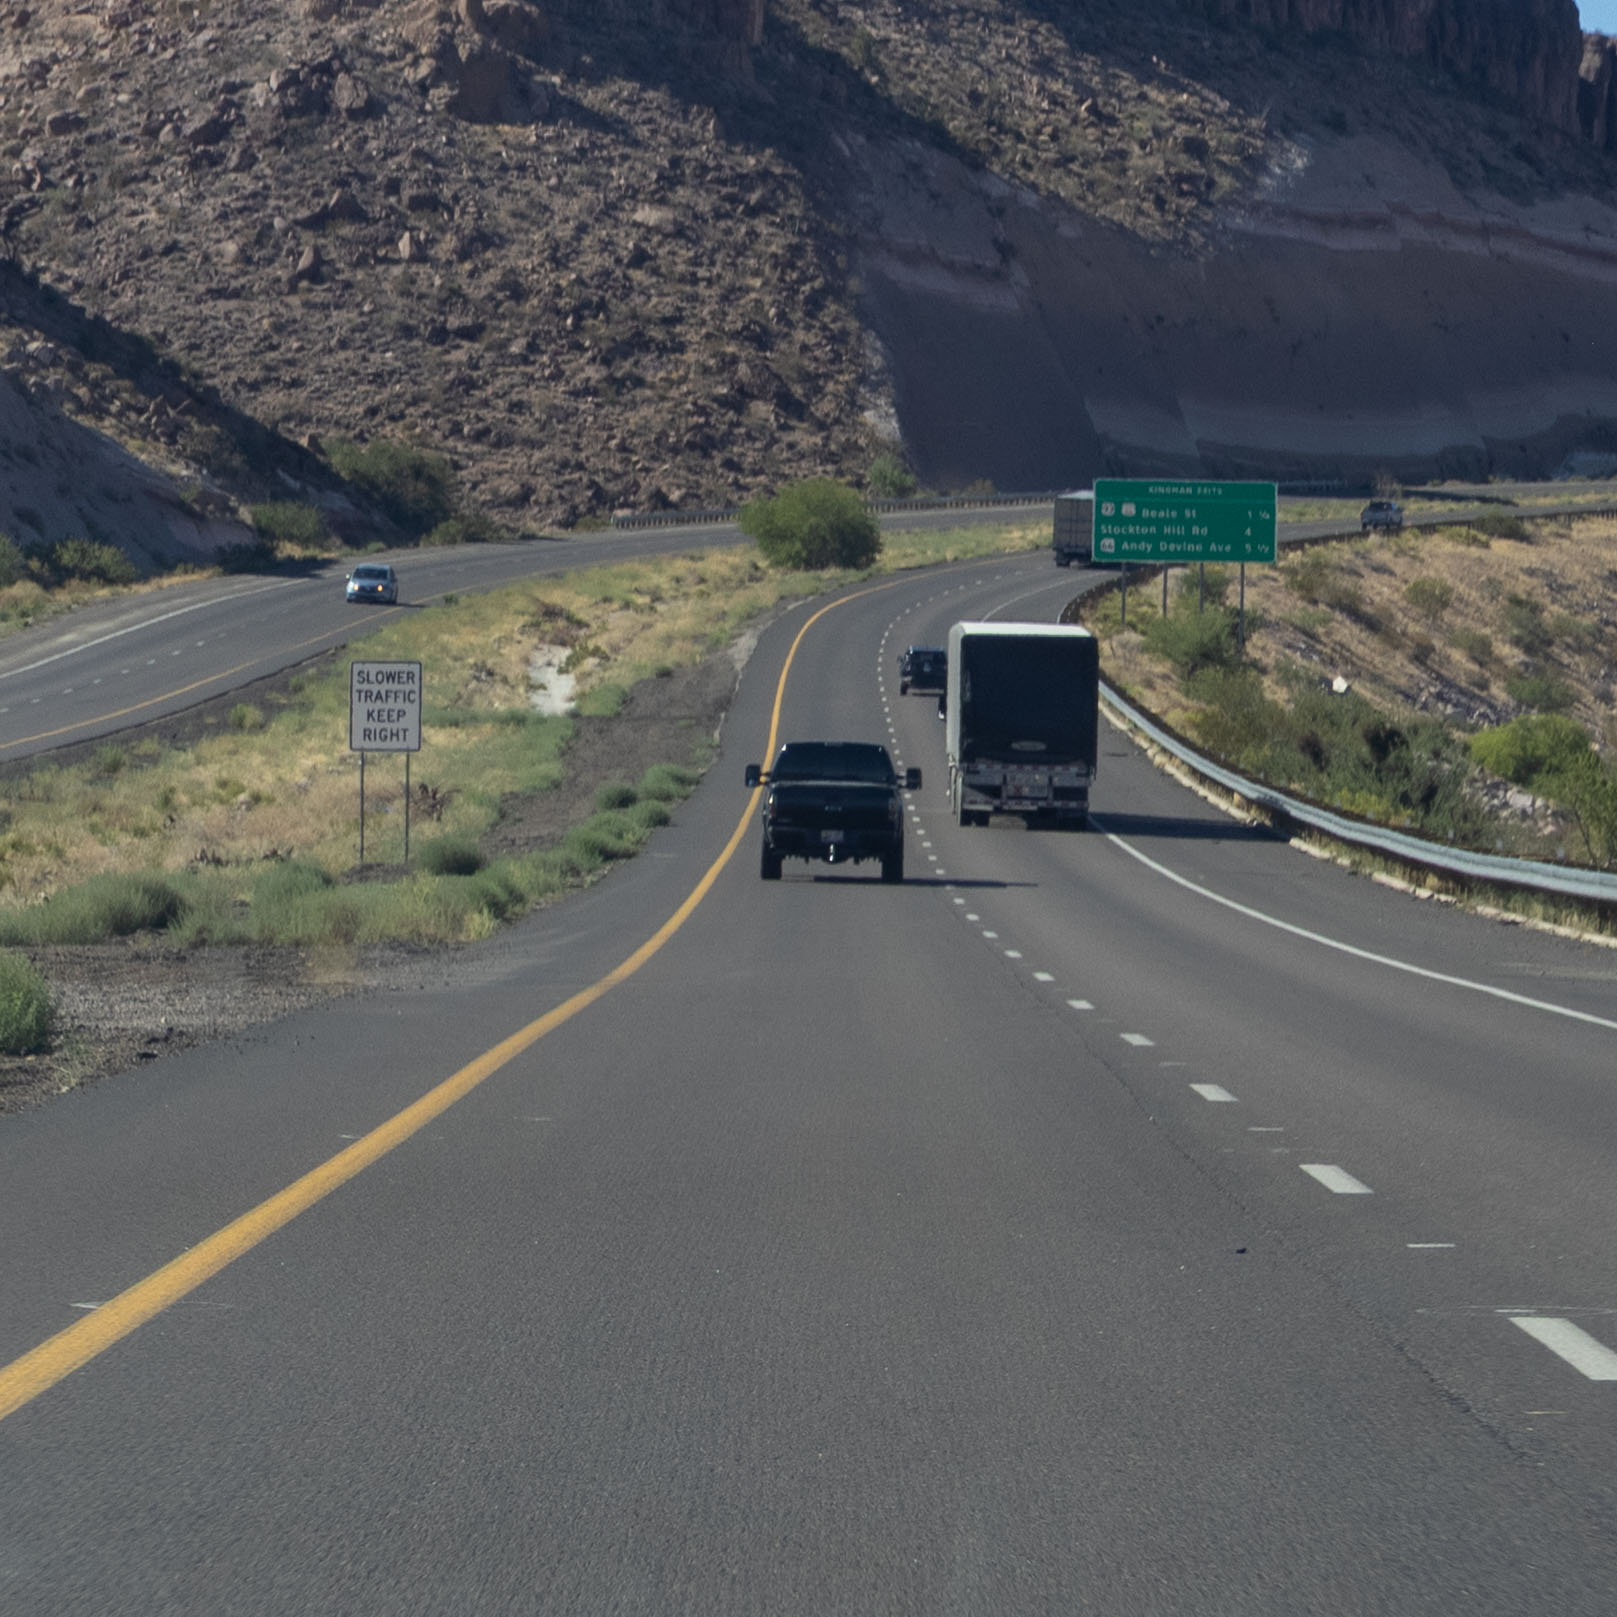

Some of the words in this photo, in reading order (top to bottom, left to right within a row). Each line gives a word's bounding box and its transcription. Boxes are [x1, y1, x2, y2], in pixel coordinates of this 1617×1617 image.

[1100, 524, 1157, 535] Stockton
[1163, 524, 1186, 536] Hill
[1191, 525, 1209, 536] Rd
[1244, 527, 1252, 537] 4
[1121, 540, 1153, 554] Andy
[1159, 541, 1203, 553] Devine
[1209, 542, 1232, 553] Ave
[356, 669, 416, 685] SLOWER
[355, 689, 417, 704] TRAFFIC
[366, 708, 407, 724] KEEP
[362, 727, 410, 743] RIGHT
